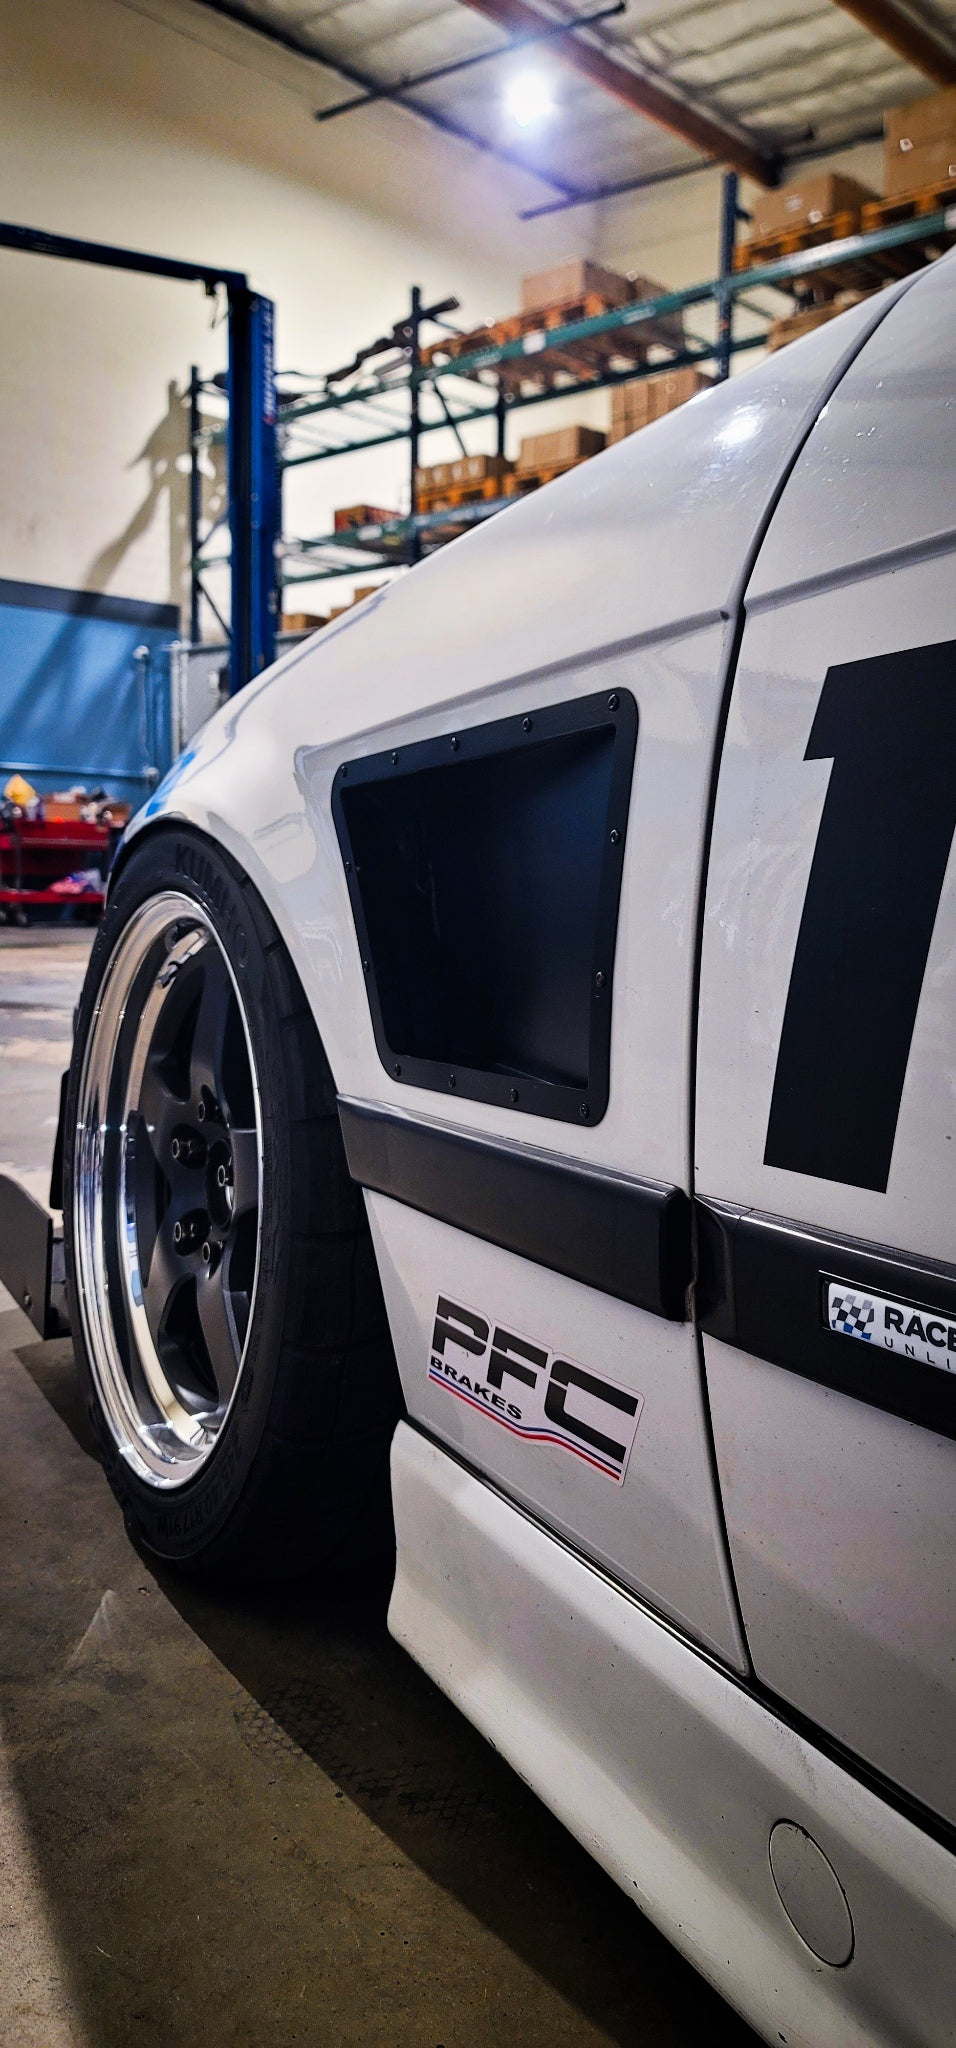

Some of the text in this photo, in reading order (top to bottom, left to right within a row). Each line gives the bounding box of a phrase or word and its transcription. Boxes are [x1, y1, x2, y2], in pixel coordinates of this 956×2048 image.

[175, 843, 248, 968] KUMHO
[763, 640, 956, 1194] 1
[430, 1355, 523, 1420] BRAKES
[431, 1294, 639, 1464] PFC
[884, 1336, 951, 1370] UNLI
